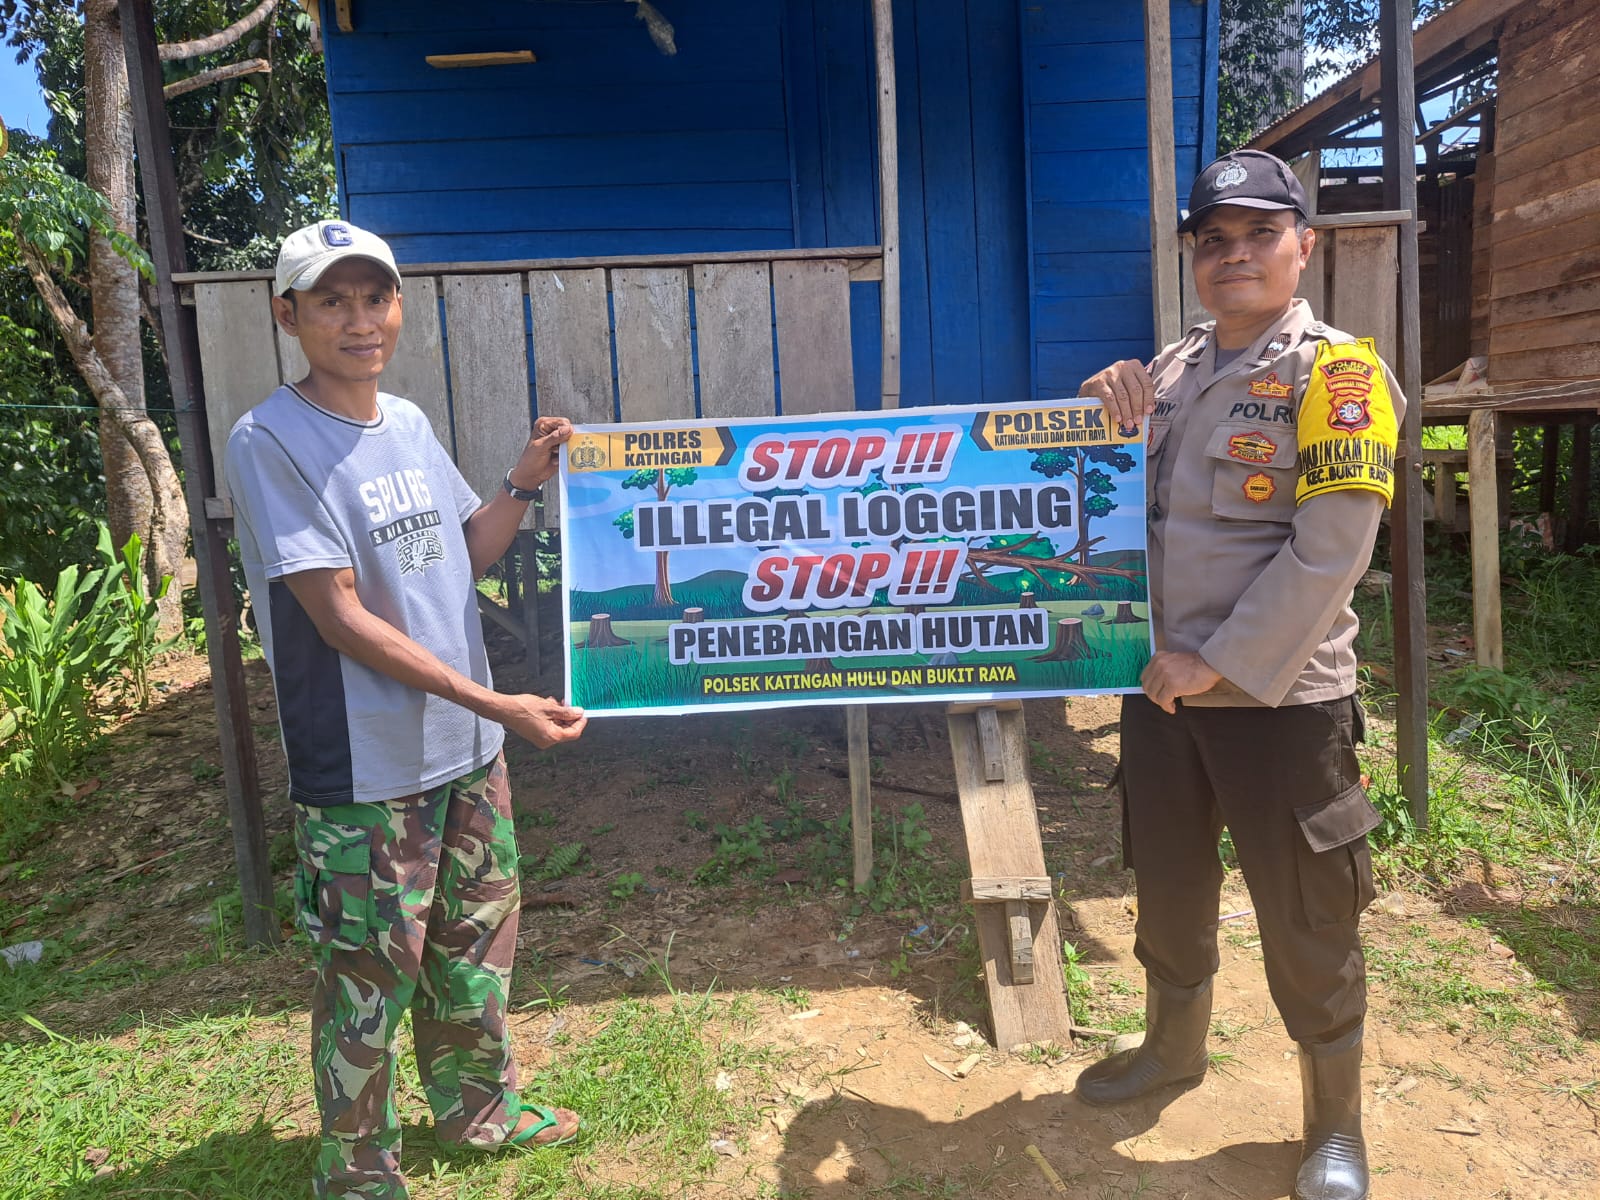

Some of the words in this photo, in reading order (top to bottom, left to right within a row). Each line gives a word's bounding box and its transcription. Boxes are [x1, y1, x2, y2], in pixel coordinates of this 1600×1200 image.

[324, 226, 353, 247] C
[994, 408, 1104, 434] POLSEK
[1229, 402, 1293, 424] POLRI
[624, 430, 702, 451] POLRES
[994, 433, 1029, 447] KATINGAN
[1030, 432, 1050, 445] HULU
[1050, 431, 1065, 443] DAN
[1066, 430, 1087, 442] BUKIT
[1088, 428, 1107, 441] RAYA
[624, 450, 702, 467] KATINGAN
[746, 437, 886, 482] STOP
[891, 431, 955, 475] !!!
[359, 469, 432, 524] SPURS
[638, 499, 831, 547] ILLEGAL
[843, 486, 1072, 538] LOGGING
[751, 553, 891, 602] STOP
[896, 549, 960, 596] !!!
[674, 617, 912, 660] PENEBANGAN
[921, 613, 1044, 649] HUTAN
[703, 675, 760, 694] POLSEK
[764, 672, 843, 691] KATINGAN
[847, 671, 887, 688] HULU
[891, 669, 922, 686] DAN
[927, 667, 974, 684] BUKIT
[978, 665, 1016, 683] RAYA
